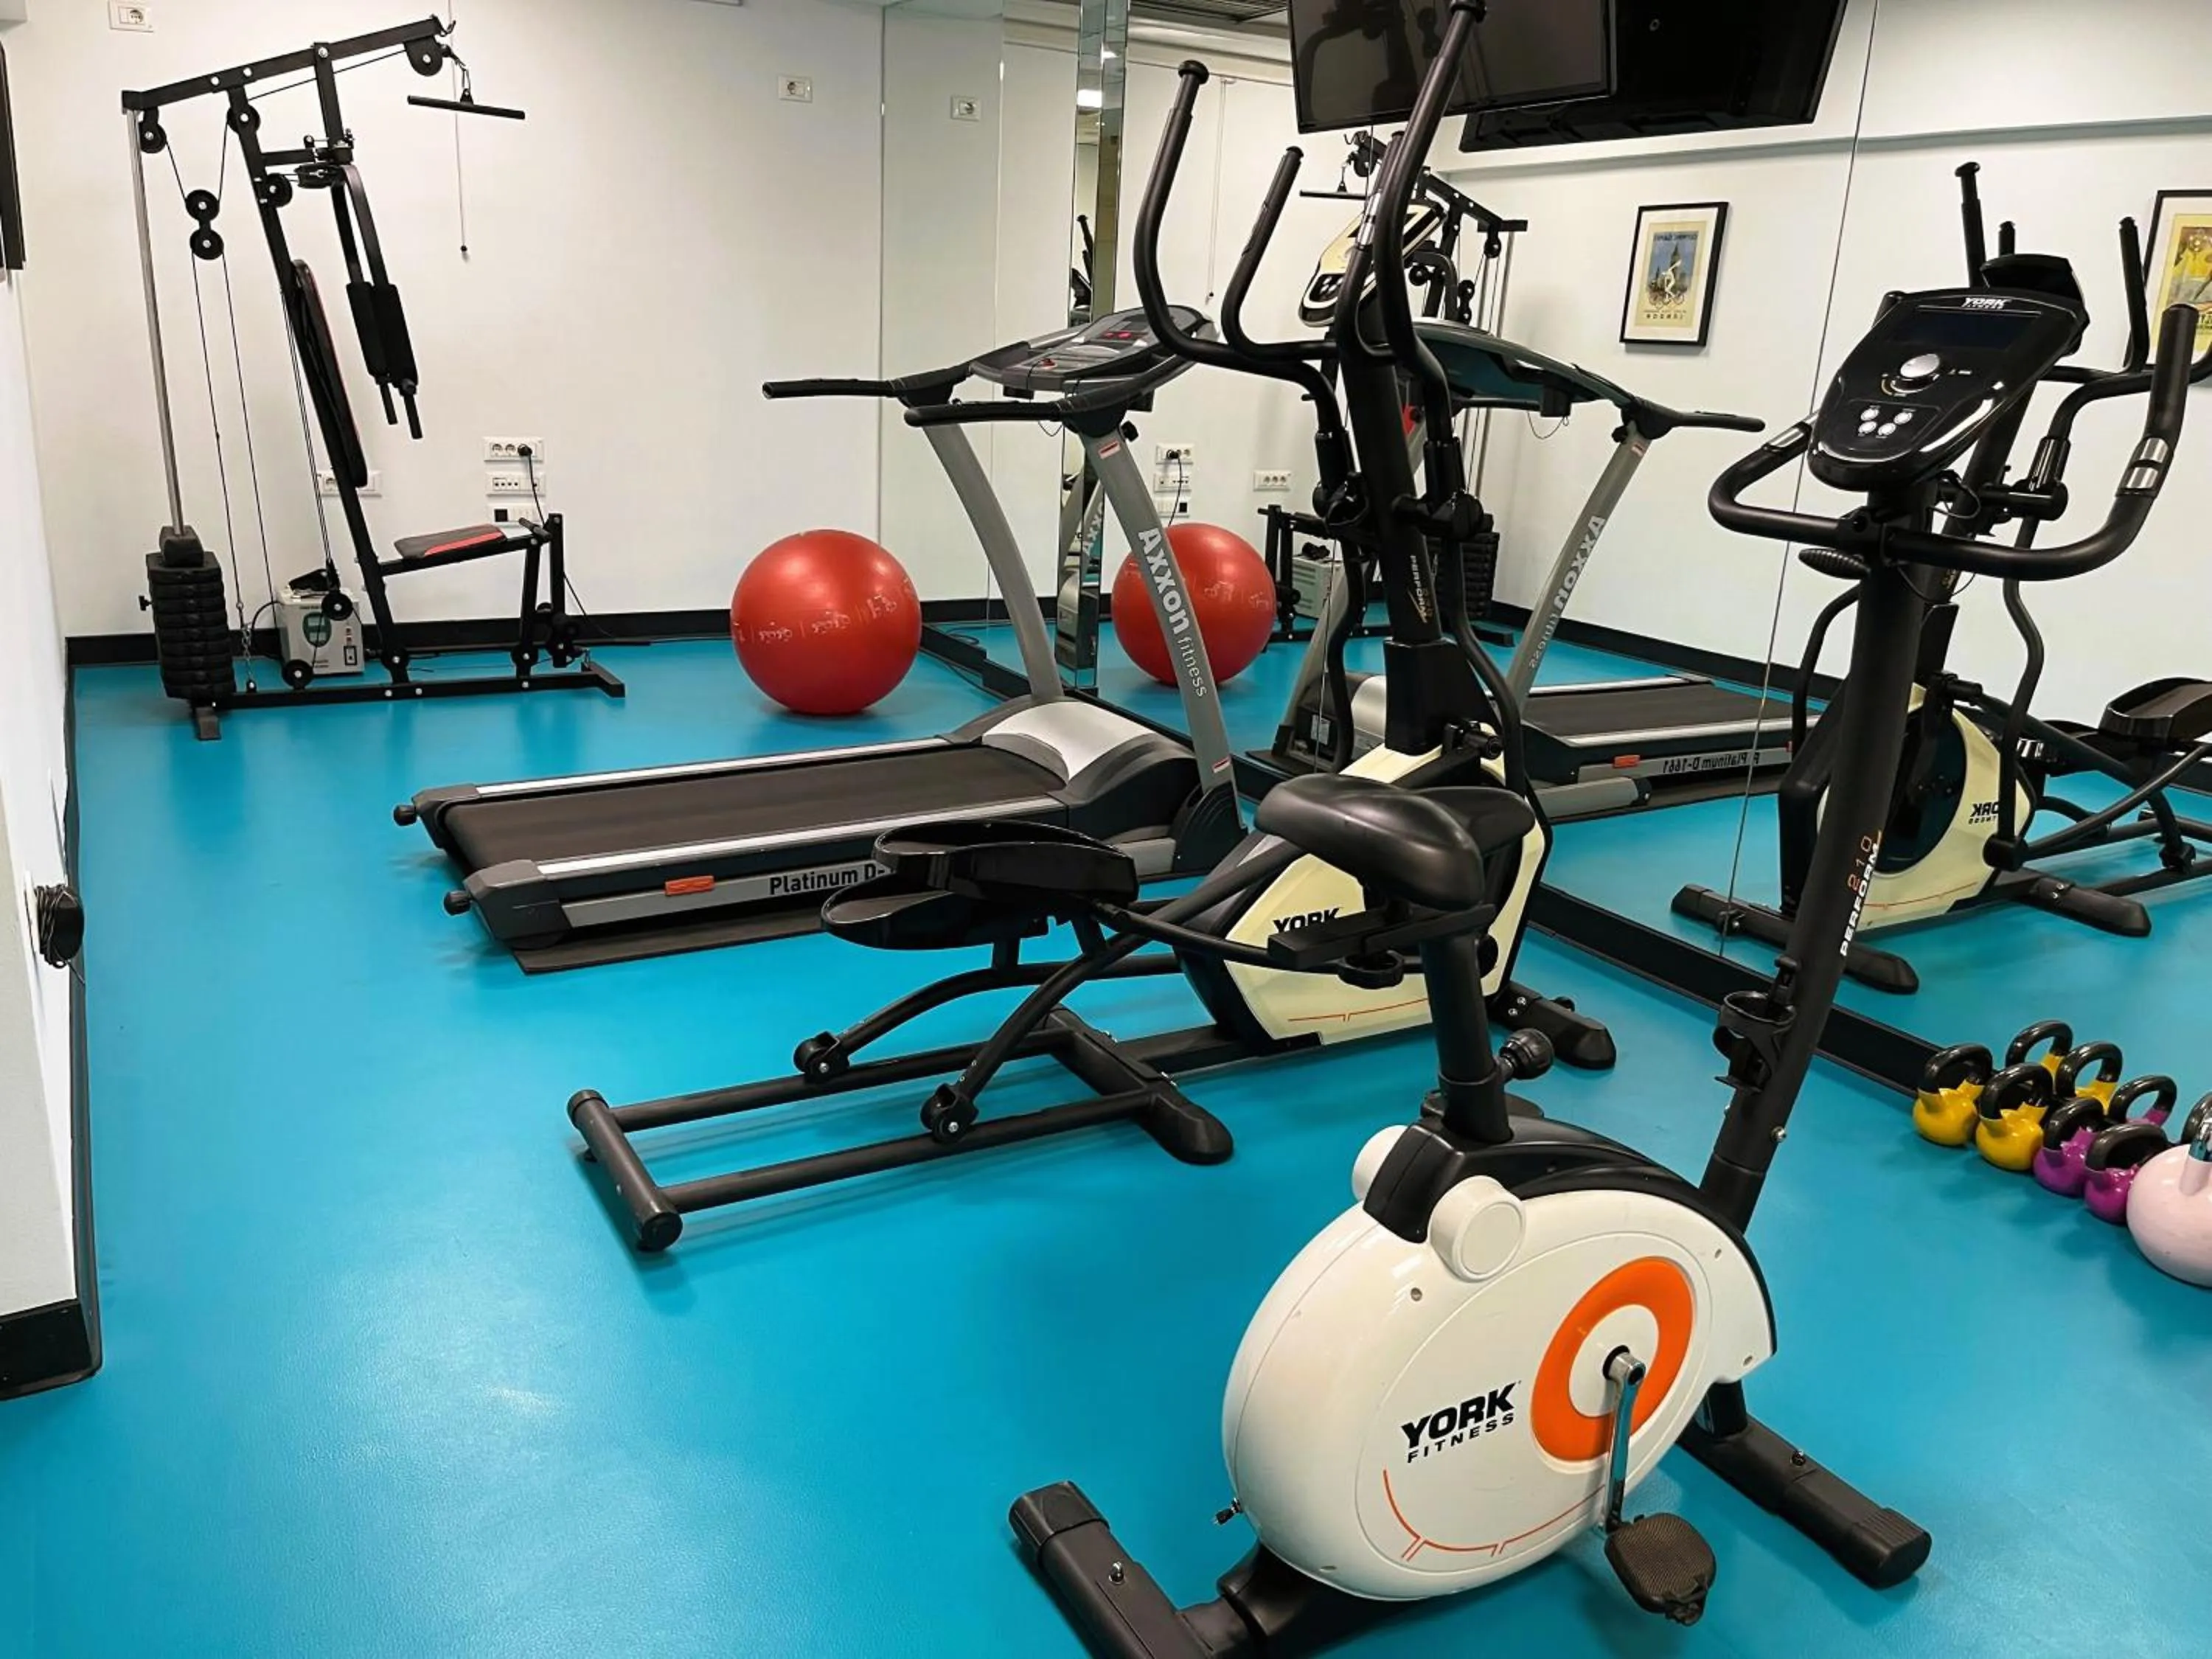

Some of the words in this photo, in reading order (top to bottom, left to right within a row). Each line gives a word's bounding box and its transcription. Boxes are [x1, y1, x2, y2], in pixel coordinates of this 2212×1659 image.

[1178, 636, 1207, 697] fitness
[770, 869, 858, 895] Platinum
[1840, 843, 1879, 956] PERFORM
[1401, 1382, 1517, 1449] YORK
[1408, 1413, 1514, 1464] FITNESS
